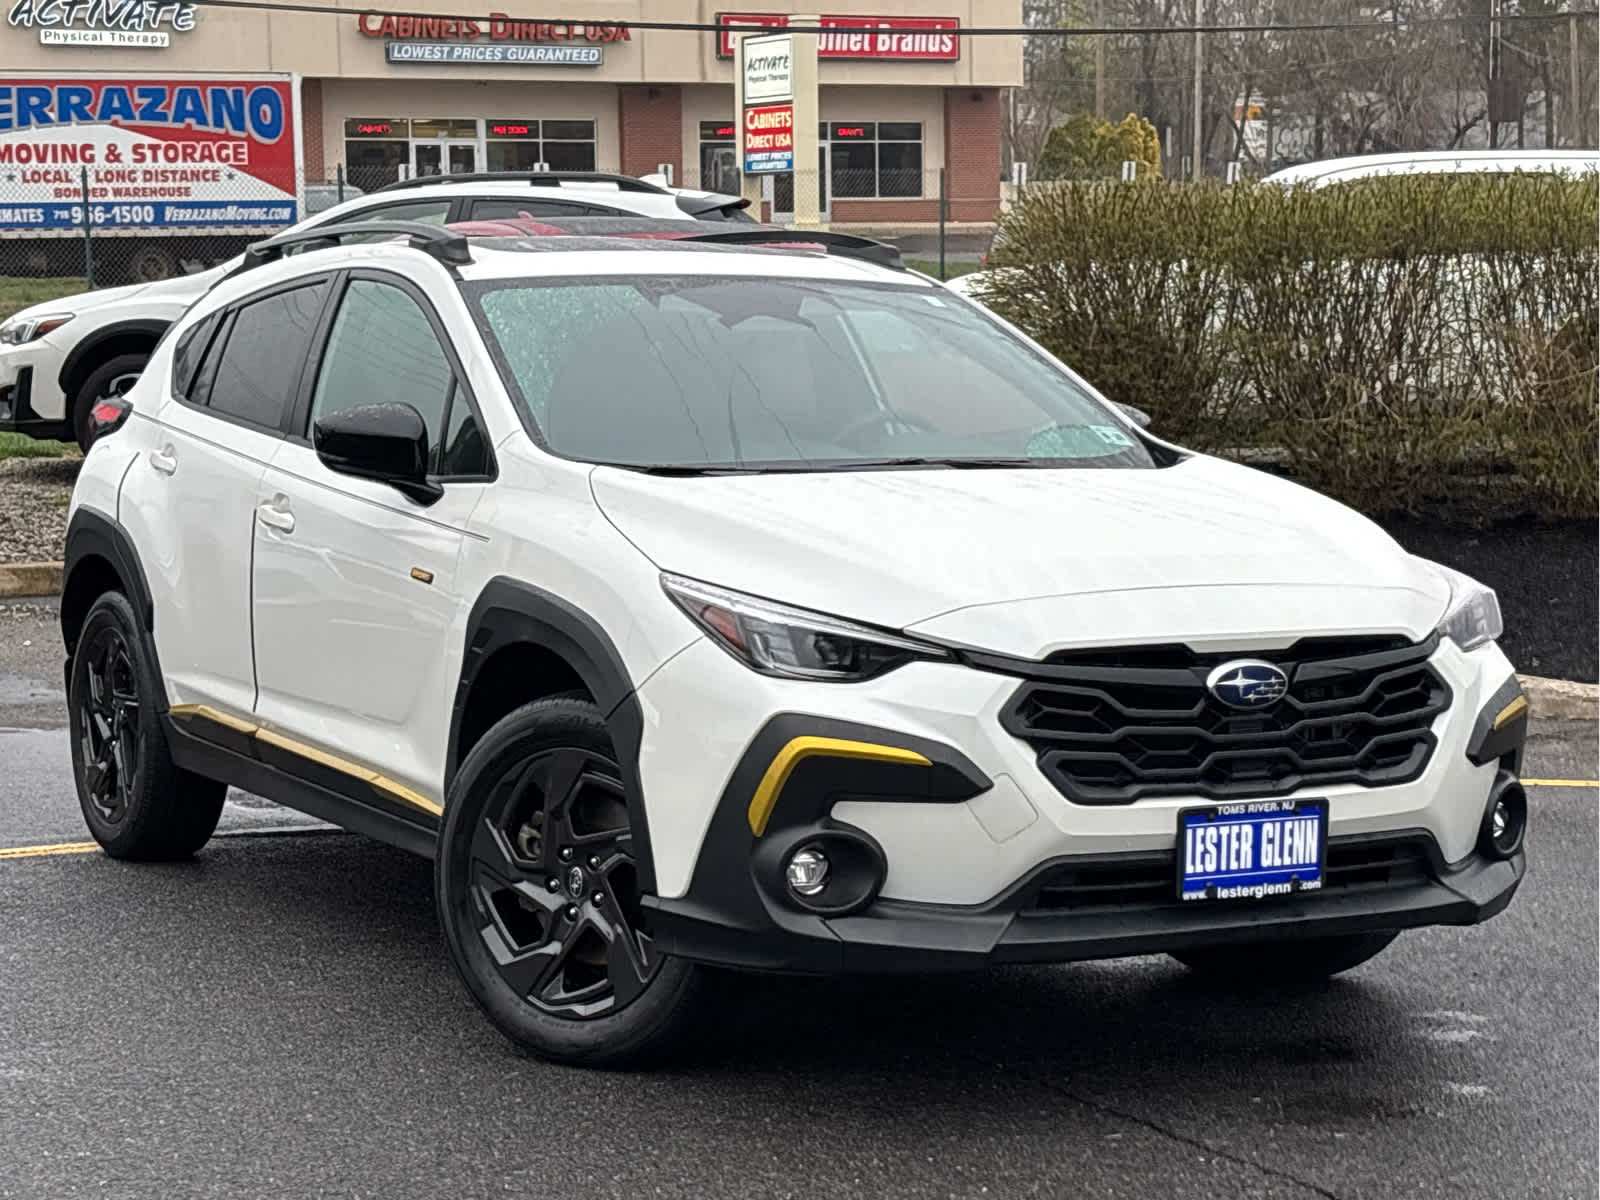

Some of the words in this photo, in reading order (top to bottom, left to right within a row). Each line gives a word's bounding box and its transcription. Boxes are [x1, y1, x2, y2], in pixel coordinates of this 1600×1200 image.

[8, 0, 198, 31] ACTIVATE
[358, 11, 480, 39] CABINETS
[489, 12, 575, 41] DIRECT
[583, 21, 632, 41] USA
[44, 30, 104, 42] Physical
[109, 32, 167, 45] Therapy
[876, 24, 954, 53] Brands
[393, 45, 451, 58] LOWEST
[453, 46, 503, 60] PRICES
[506, 47, 599, 61] GUARANTEED
[747, 55, 789, 72] ACTIVATE
[746, 110, 791, 130] CABINETS
[746, 133, 773, 149] DIRECT
[775, 133, 791, 147] USA
[0, 143, 95, 164] MOVING
[104, 143, 122, 164] &
[132, 143, 247, 164] STORAGE
[22, 169, 73, 183] LOCAL
[94, 169, 137, 183] LONG
[142, 169, 220, 183] DISTANCE
[111, 186, 191, 198] WAREHOUSE
[1217, 805, 1245, 815] TOMS
[1185, 824, 1253, 874] LESTER
[1260, 819, 1319, 868] GLENN
[1217, 884, 1291, 899] lesterglenn
